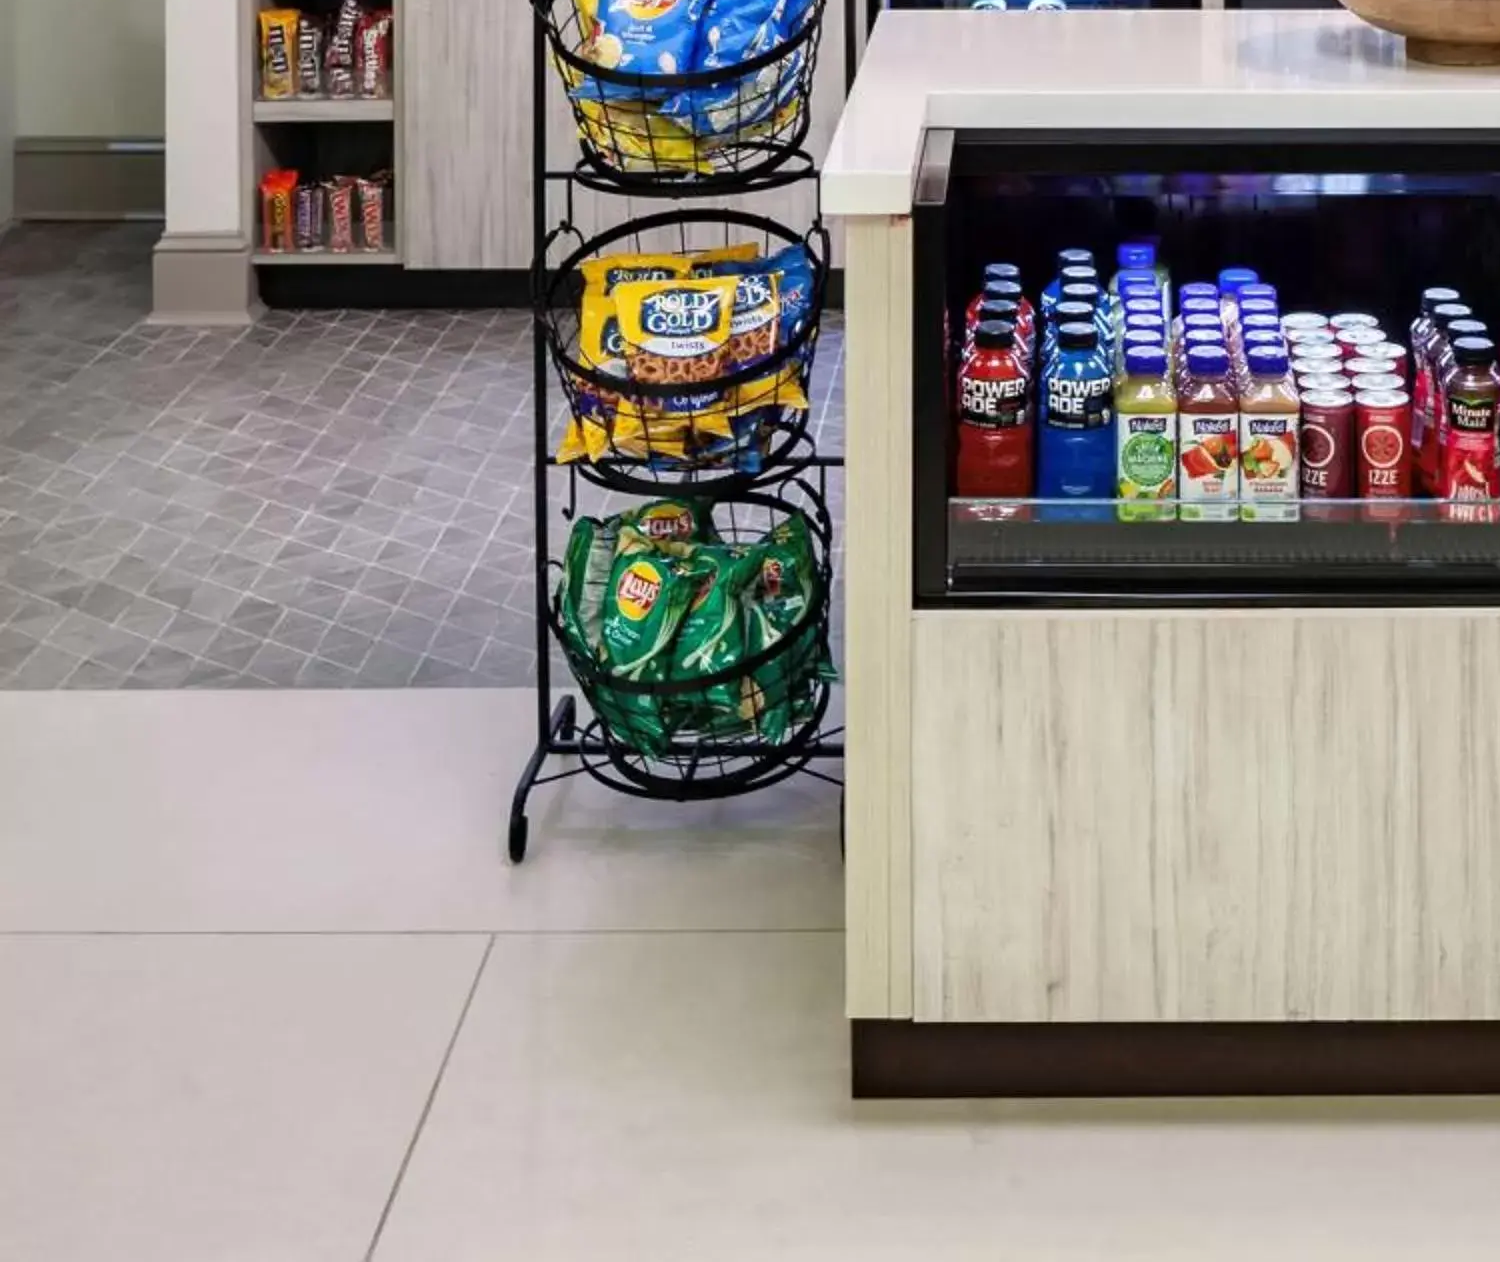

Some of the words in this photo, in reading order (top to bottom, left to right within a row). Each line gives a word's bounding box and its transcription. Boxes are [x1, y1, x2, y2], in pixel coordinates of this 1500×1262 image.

[653, 293, 711, 312] ROLD
[648, 313, 713, 333] GOLD
[962, 377, 1025, 398] POWER
[1048, 377, 1111, 398] POWER
[962, 397, 998, 415] ADE
[1048, 397, 1085, 415] ADE
[1452, 403, 1491, 418] Minute
[1457, 414, 1488, 428] Maid
[1303, 471, 1329, 486] ZZE
[1369, 469, 1399, 485] IZZE
